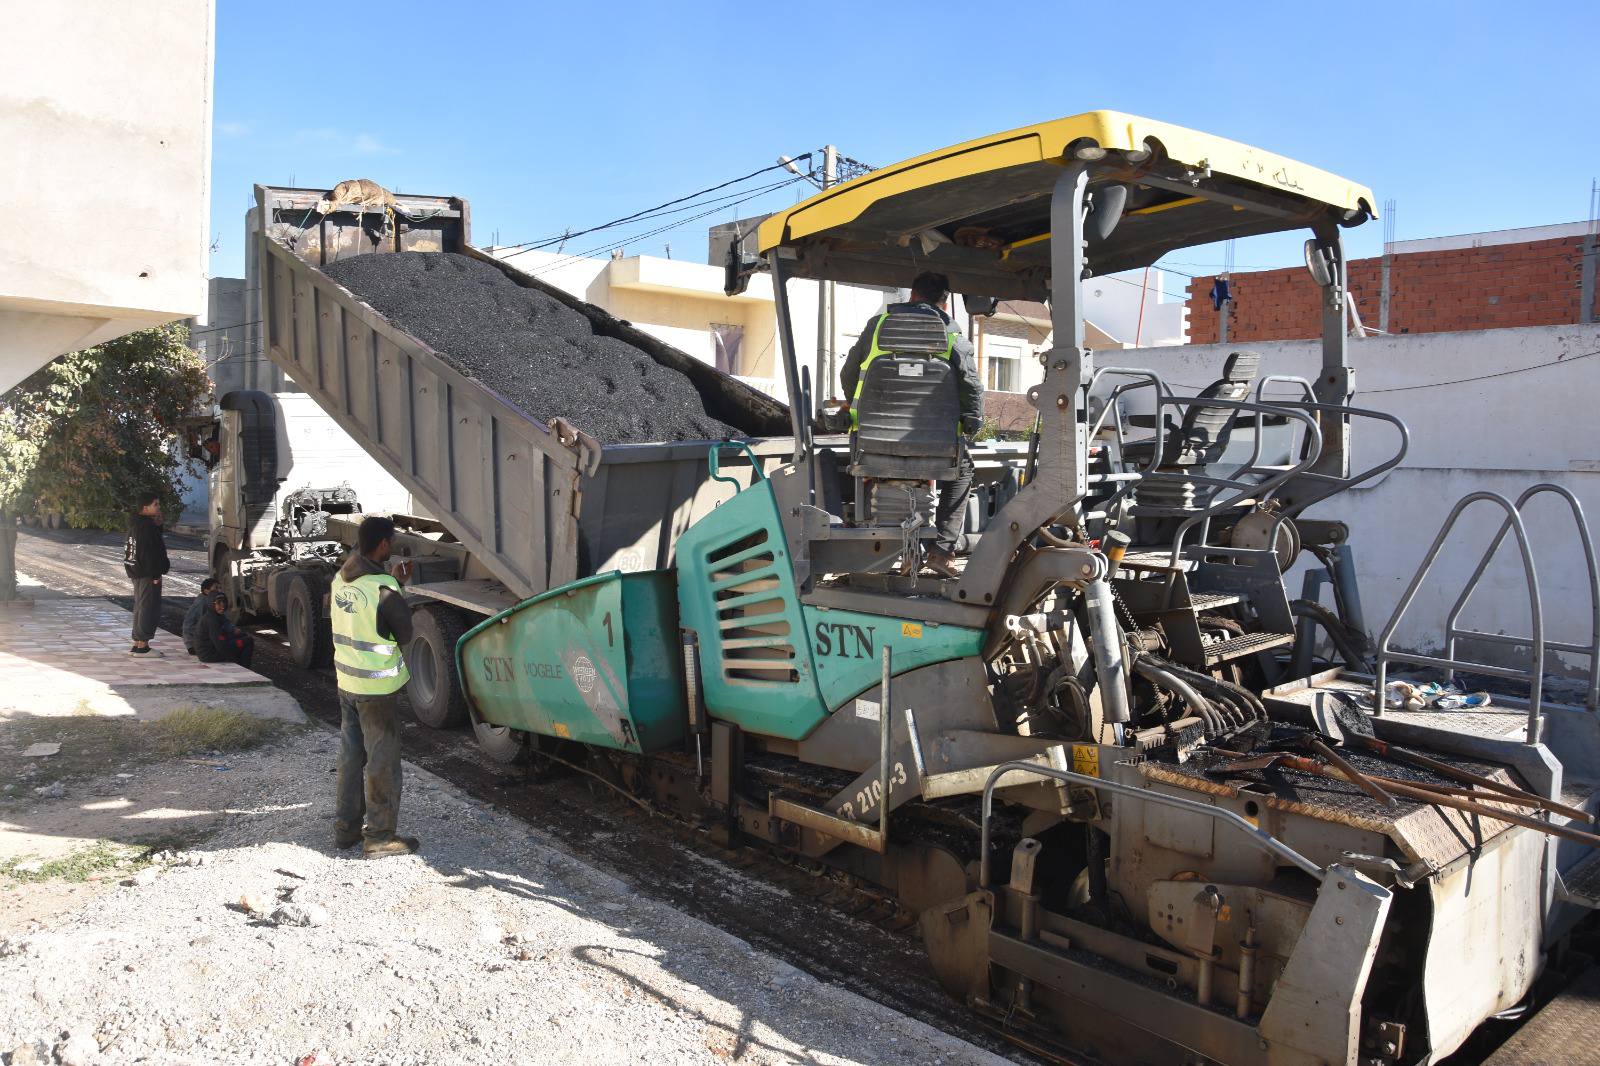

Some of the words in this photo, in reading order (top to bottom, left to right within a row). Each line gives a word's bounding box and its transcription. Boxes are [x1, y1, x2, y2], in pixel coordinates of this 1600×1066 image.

[602, 611, 614, 648] 1
[815, 621, 876, 660] STN
[482, 656, 516, 682] STN
[856, 762, 907, 814] 210-3
